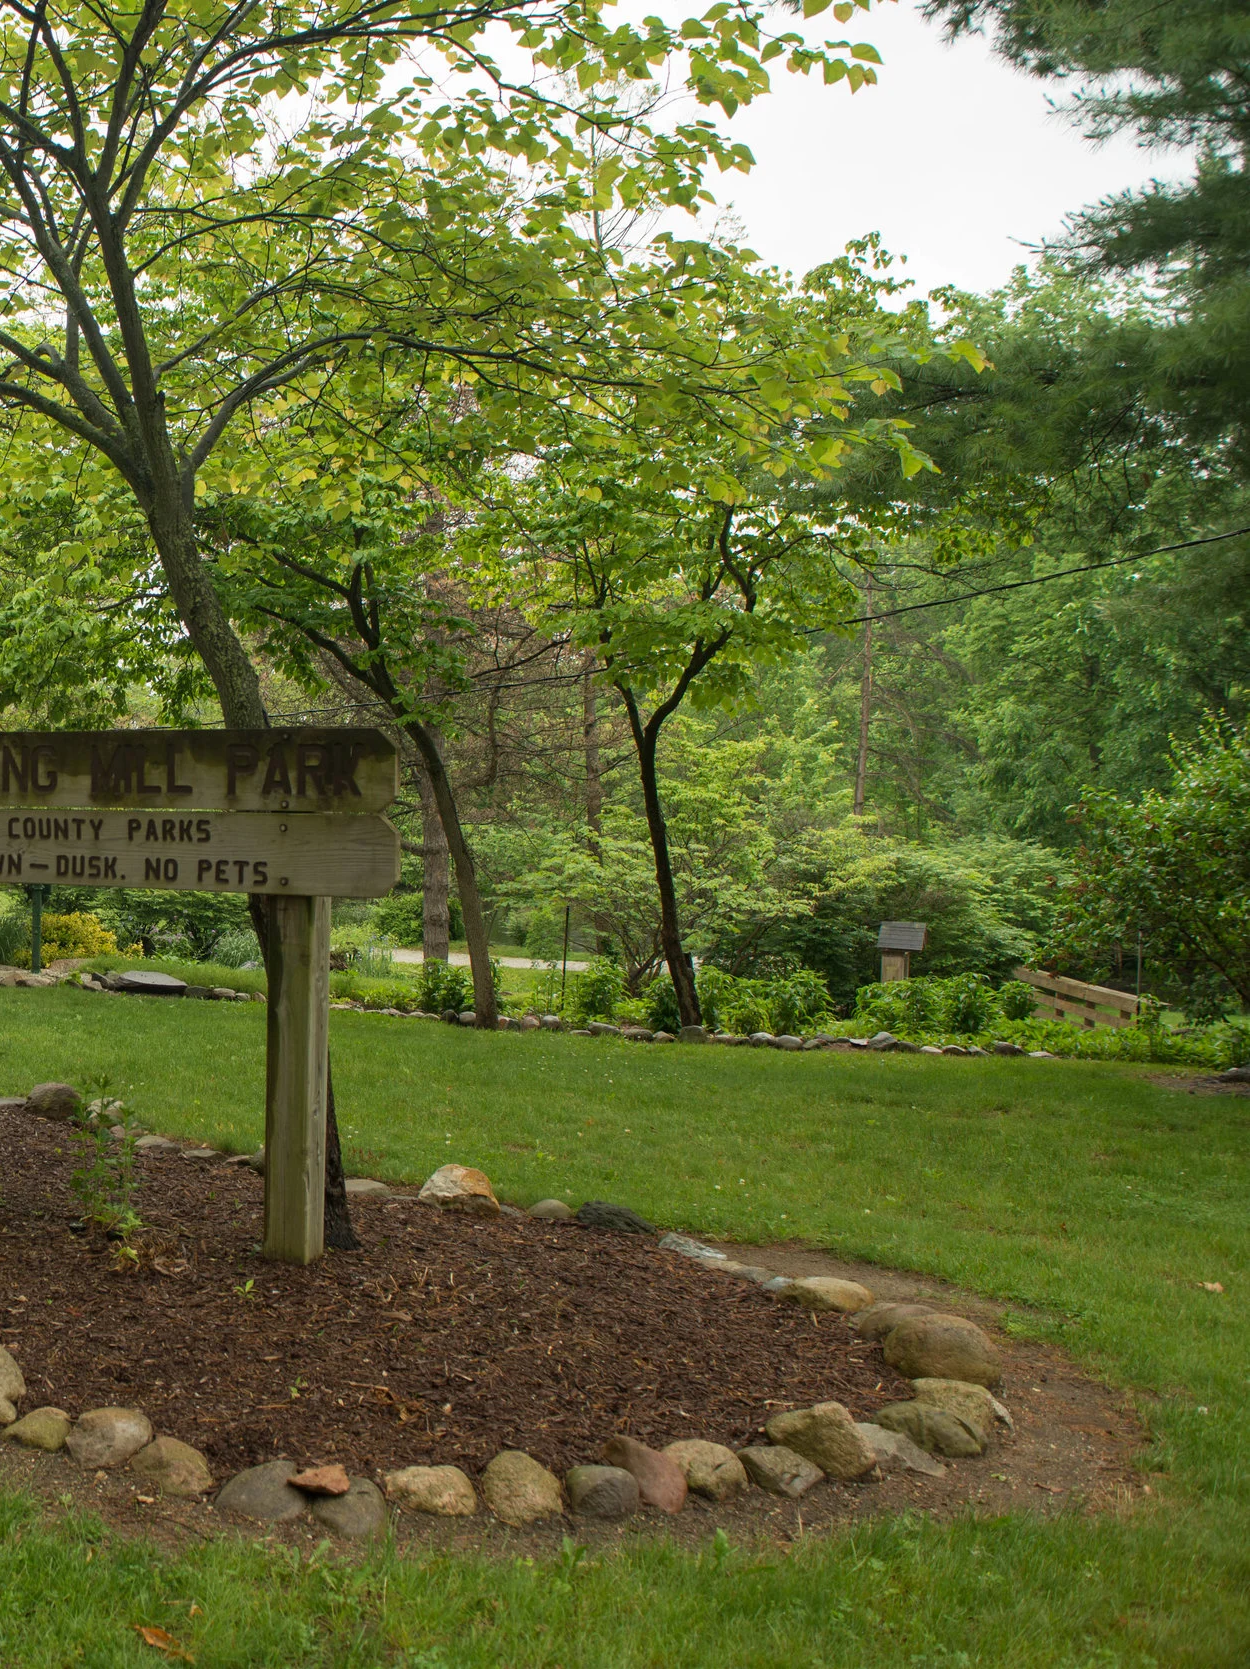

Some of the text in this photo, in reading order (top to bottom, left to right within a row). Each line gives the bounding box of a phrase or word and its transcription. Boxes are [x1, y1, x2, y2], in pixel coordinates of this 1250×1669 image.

[90, 743, 194, 796] MILL
[225, 742, 364, 797] PARK
[7, 816, 104, 841] COUNTY
[127, 818, 212, 843] PARKS
[144, 857, 179, 882] NO
[197, 859, 269, 886] PETS
